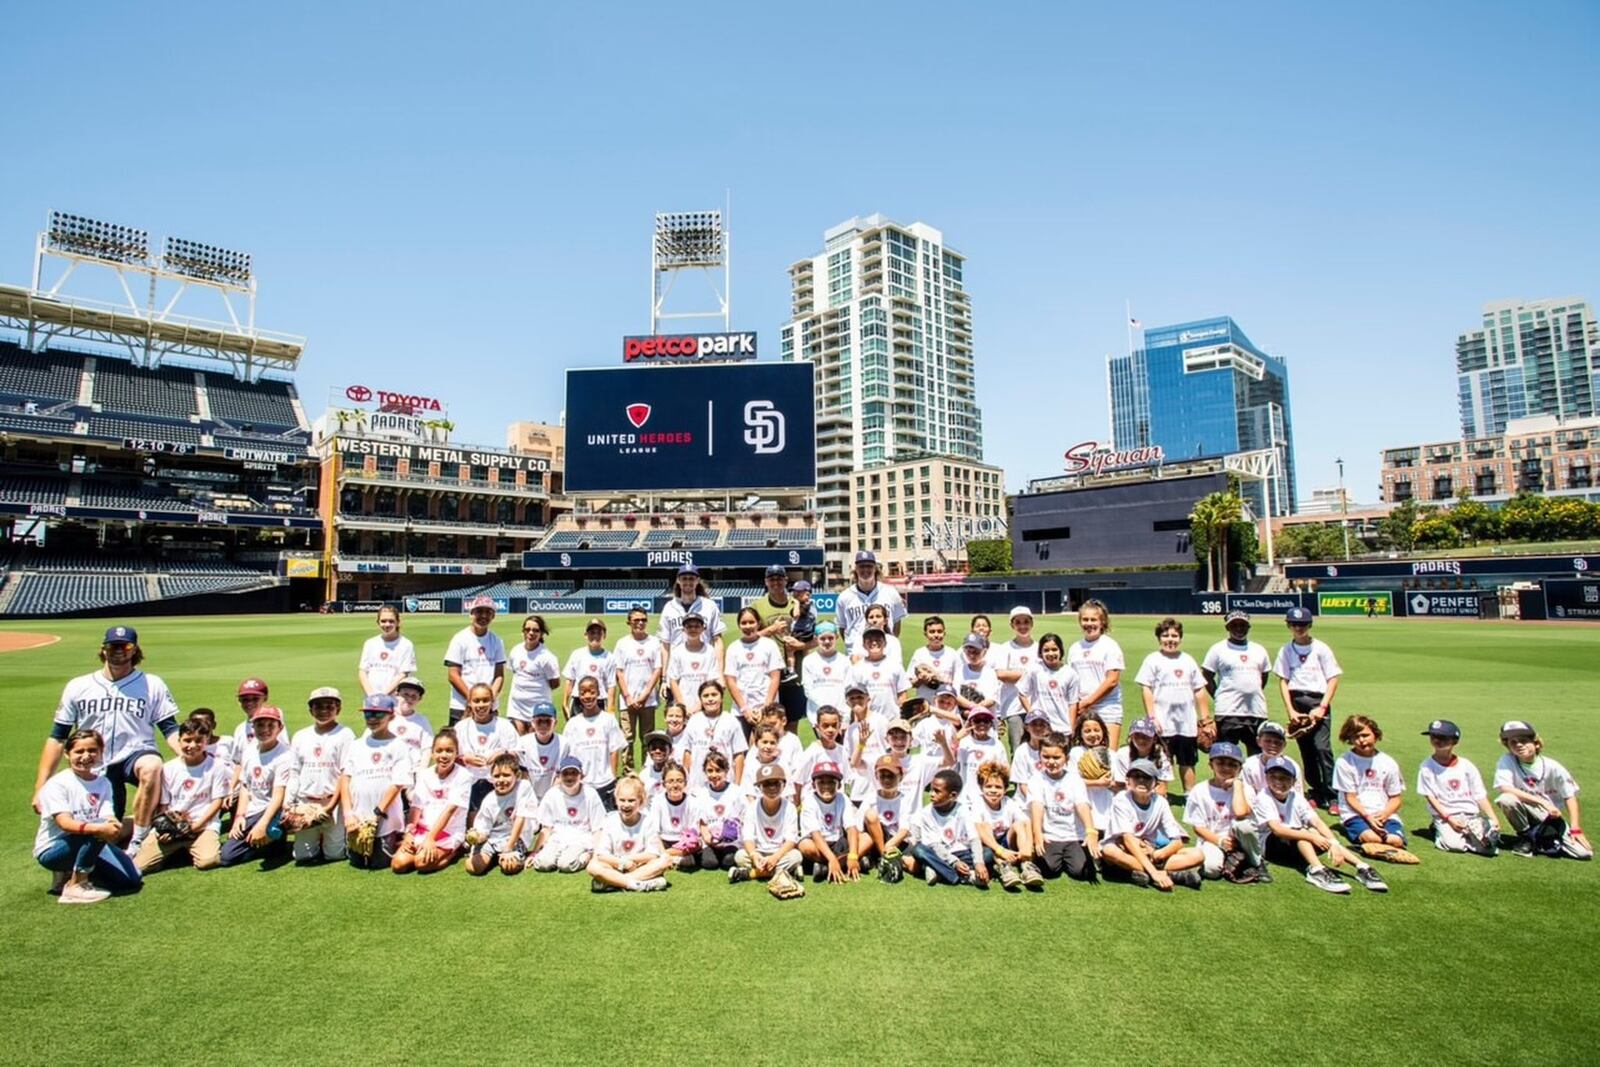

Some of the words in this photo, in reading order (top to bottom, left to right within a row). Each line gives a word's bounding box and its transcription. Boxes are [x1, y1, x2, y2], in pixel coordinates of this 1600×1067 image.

[377, 391, 441, 411] TOYOTA
[371, 413, 421, 436] PADRES
[130, 439, 165, 451] 12:10
[587, 433, 636, 445] UNITED
[639, 432, 692, 444] HEROES
[233, 449, 289, 463] CUTWATER
[336, 437, 412, 459] WESTERN
[419, 447, 467, 464] METAL
[471, 453, 523, 470] SUPPLY
[528, 459, 550, 473] CO.
[1063, 441, 1163, 478] Sycuan
[30, 504, 67, 516] PADRES
[198, 511, 228, 524] PADRES
[647, 551, 693, 567] PADRES
[1412, 561, 1461, 576] PADRES
[529, 600, 583, 611] Qualcomm
[607, 600, 652, 610] GEICO
[1202, 601, 1222, 613] 396
[1255, 600, 1273, 609] Diego
[1273, 600, 1295, 608] Health
[76, 697, 146, 719] PADRES
